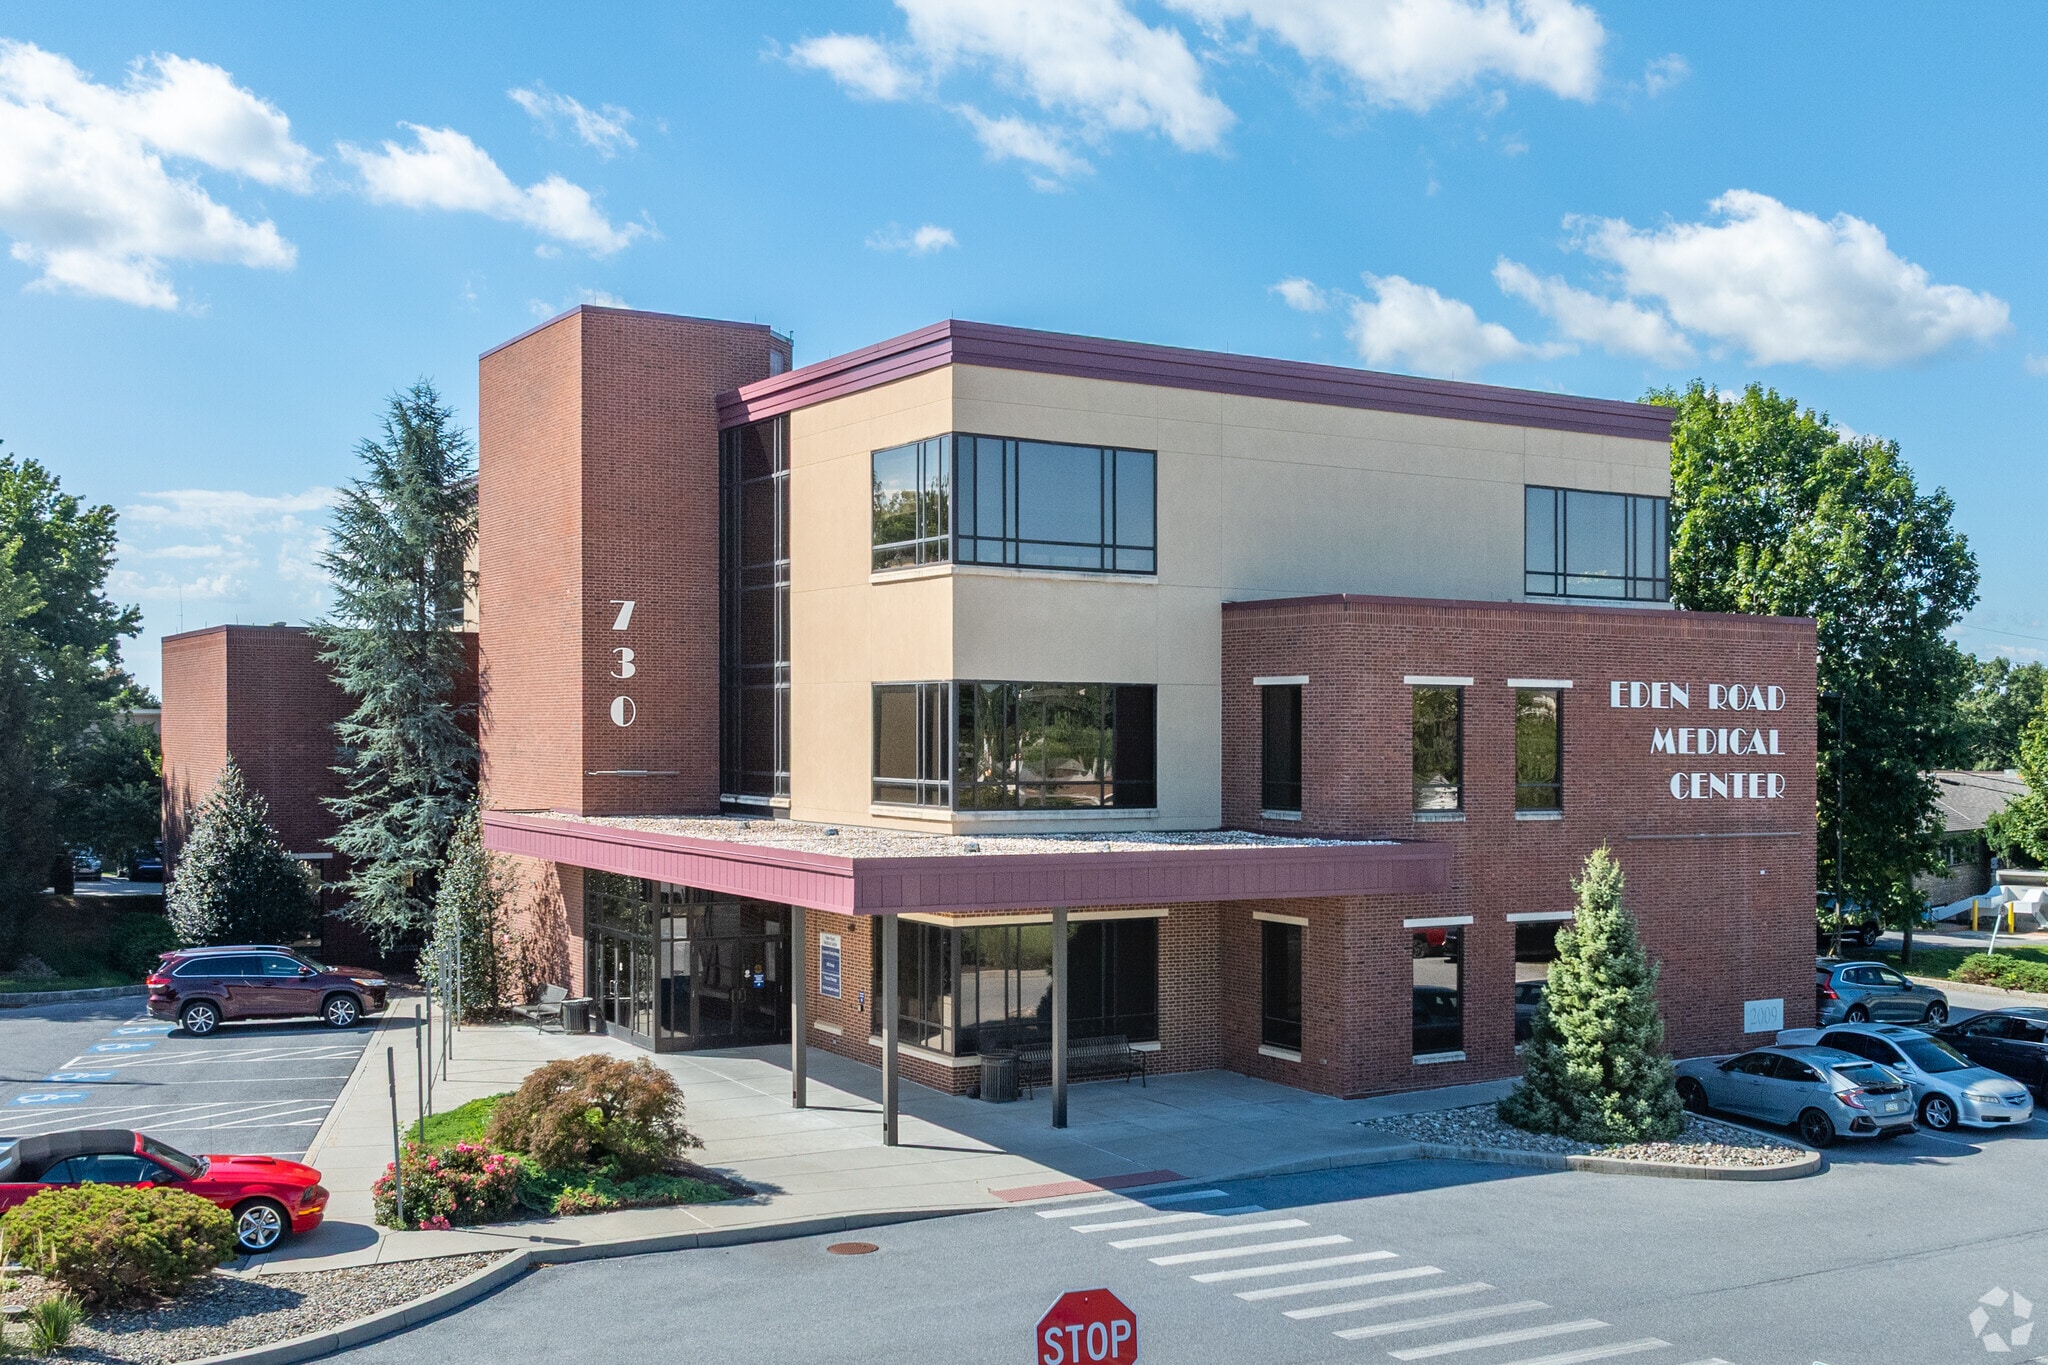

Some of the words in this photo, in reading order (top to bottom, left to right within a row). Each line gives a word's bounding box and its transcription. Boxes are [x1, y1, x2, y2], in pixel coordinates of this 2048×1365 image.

[610, 600, 636, 727] 730
[1610, 681, 1689, 709] EDEN
[1708, 683, 1786, 711] ROAD
[1650, 727, 1785, 755] MEDICAL
[1669, 772, 1786, 800] CENTER
[1750, 1006, 1778, 1025] 2009
[1043, 1319, 1132, 1365] STOP
